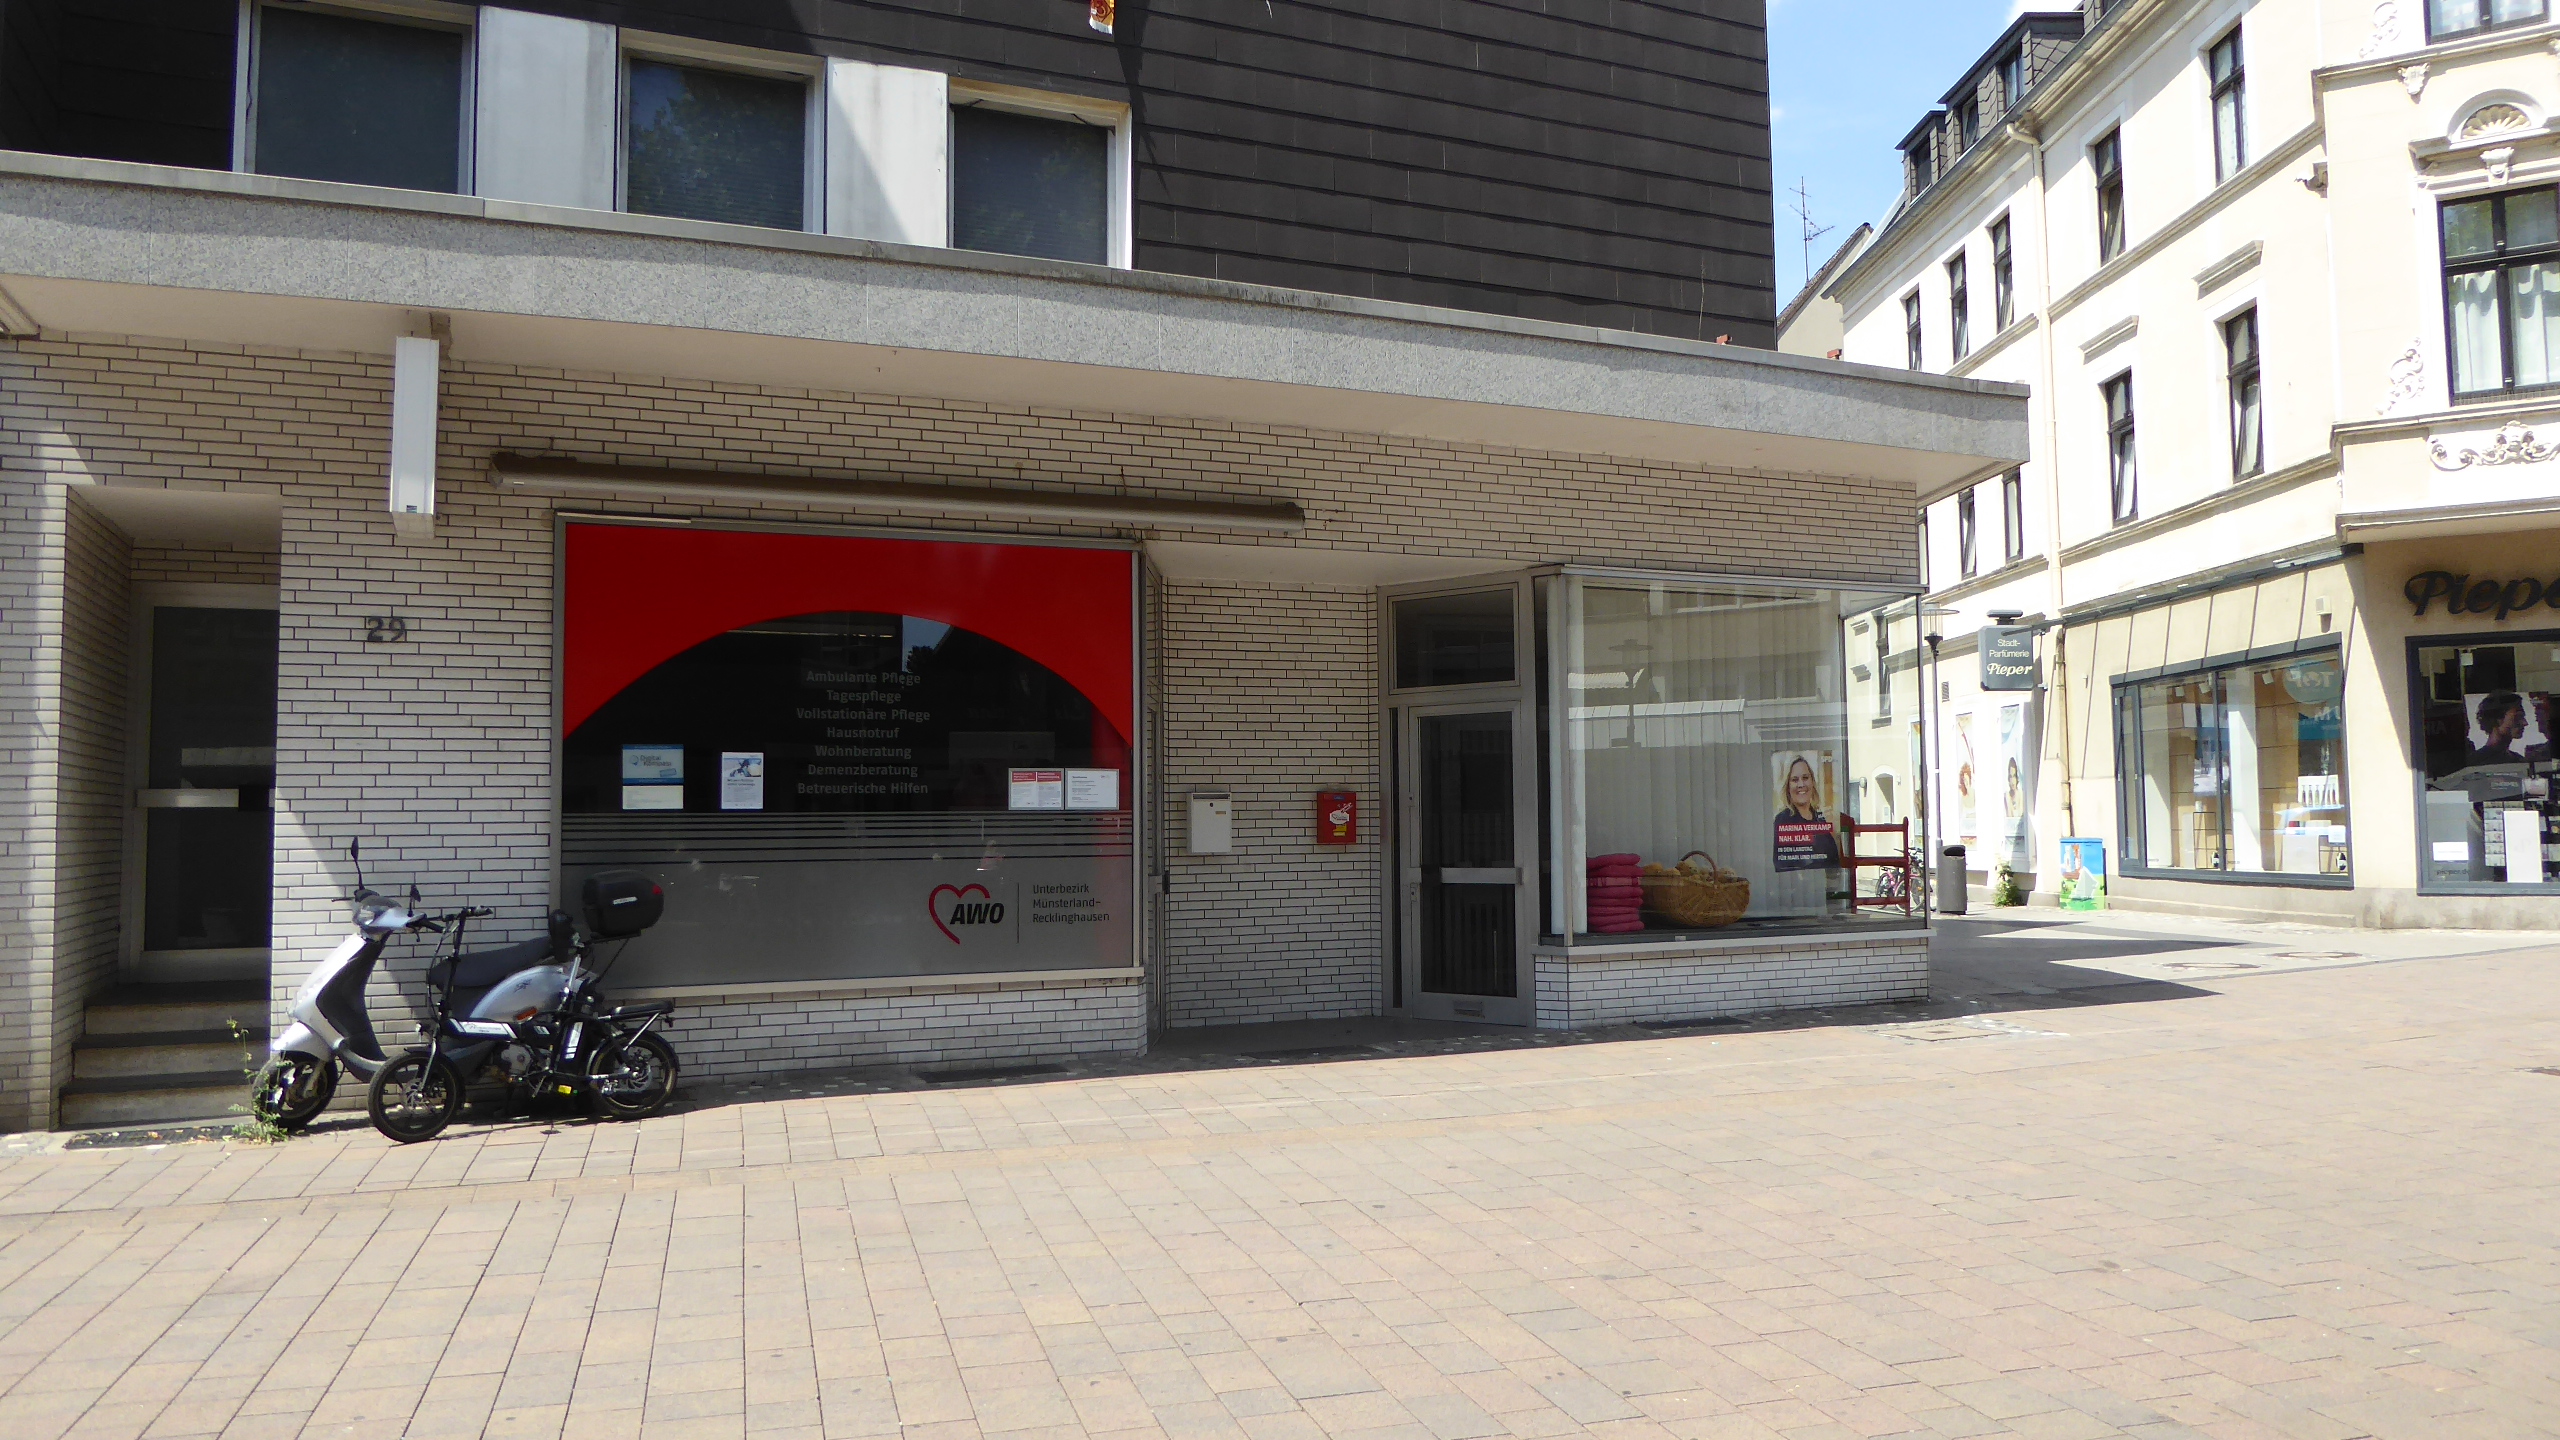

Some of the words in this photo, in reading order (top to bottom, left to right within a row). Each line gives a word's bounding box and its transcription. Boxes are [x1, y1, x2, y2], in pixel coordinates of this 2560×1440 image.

[367, 615, 406, 642] 29
[1997, 638, 2021, 647] Stadt-
[1988, 649, 2030, 658] Parfümerie
[1986, 662, 2033, 677] Pieper
[806, 670, 878, 683] Ambulante
[881, 672, 921, 686] Pflege
[826, 689, 902, 704] Tagespflege
[796, 708, 887, 721] Vollstationäre
[891, 709, 931, 723] Pflege
[826, 727, 901, 739] Hausnotruf
[814, 745, 912, 760] Wohnberatung
[807, 764, 919, 778] Demenzberatung
[797, 782, 887, 794] Betreuerische
[890, 782, 929, 795] Hilfen
[1778, 824, 1803, 832] MARINA
[1803, 823, 1832, 832] VERKAMP
[1794, 834, 1811, 842] KLAR.
[1032, 883, 1090, 895] Unterbezirk
[1032, 897, 1102, 909] Münsterland-
[949, 902, 1005, 925] AWO
[1032, 912, 1110, 925] Recklinghausen
